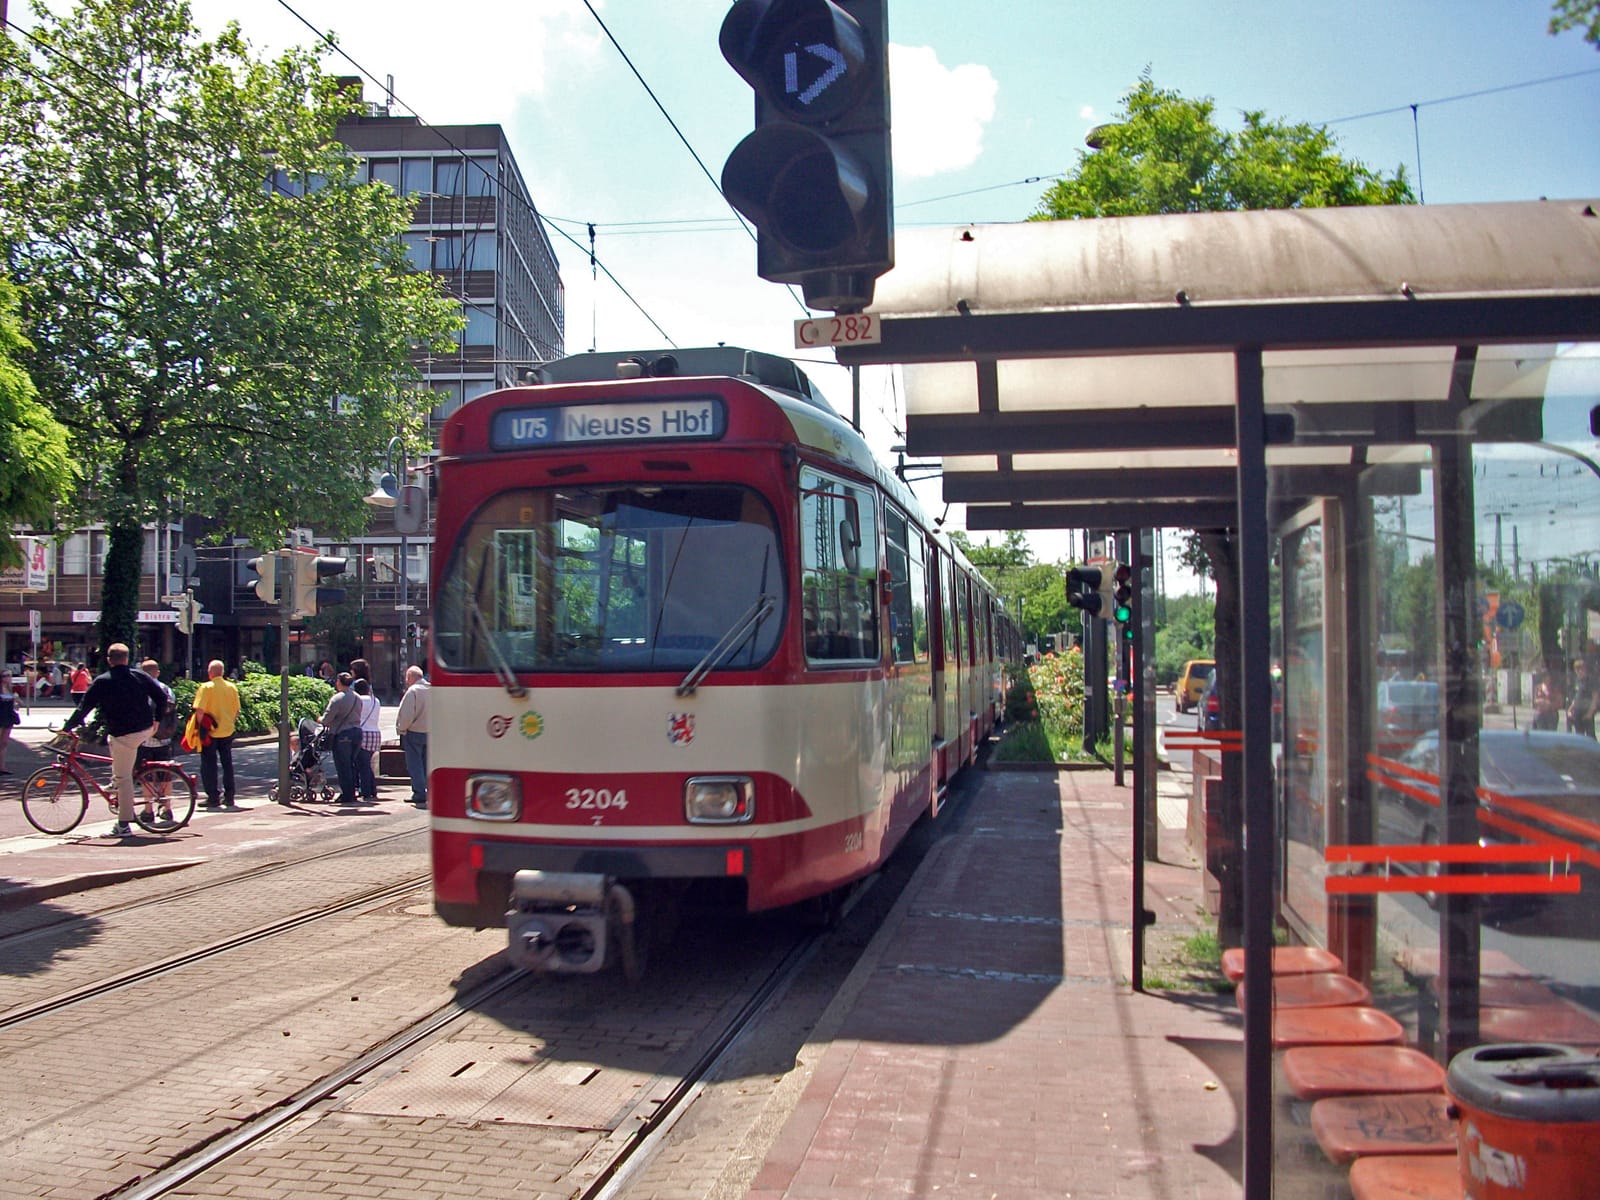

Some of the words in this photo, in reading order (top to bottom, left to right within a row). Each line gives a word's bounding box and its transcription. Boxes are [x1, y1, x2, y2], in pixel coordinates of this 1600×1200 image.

[799, 320, 814, 345] C
[830, 315, 873, 342] 282
[511, 417, 547, 440] U75
[567, 413, 652, 438] Neuss
[661, 408, 709, 434] Hbf
[564, 787, 629, 810] 3204
[845, 831, 862, 853] 3204
